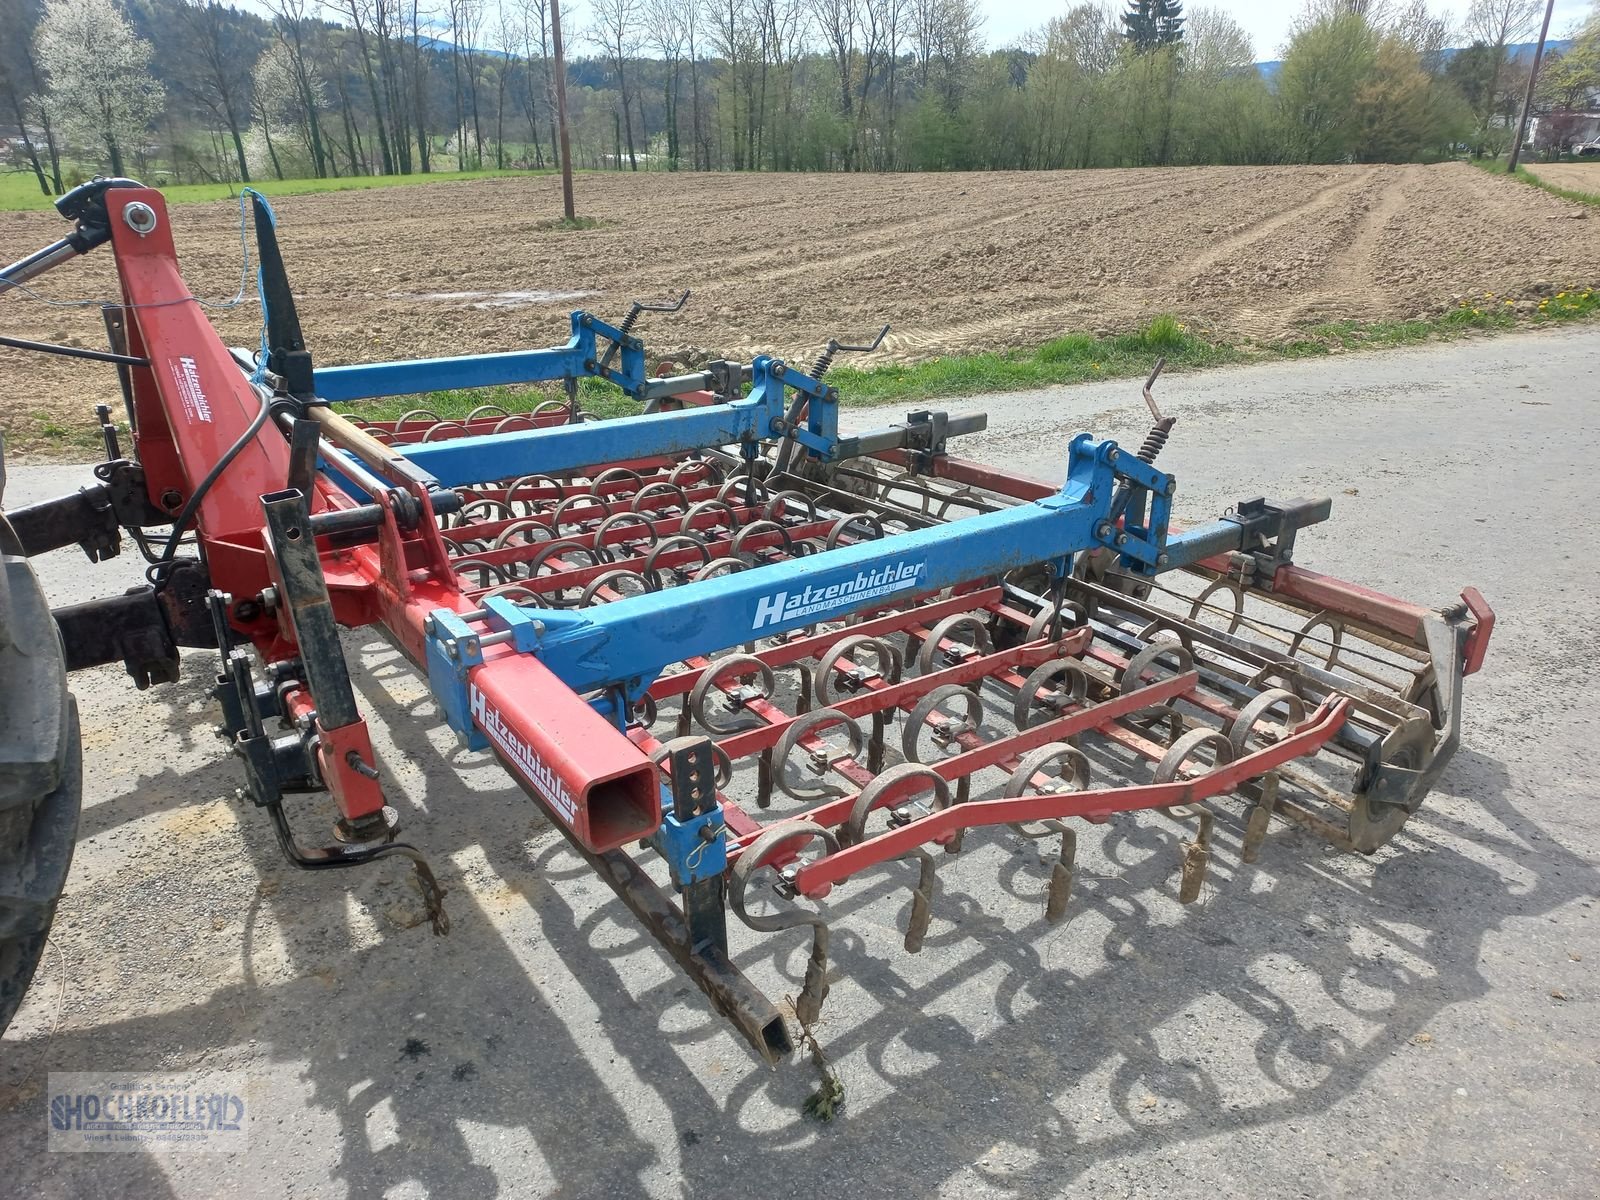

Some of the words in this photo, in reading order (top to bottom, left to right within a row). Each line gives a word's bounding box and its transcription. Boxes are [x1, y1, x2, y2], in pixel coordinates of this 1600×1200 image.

[180, 357, 212, 423] Hatzenbichler
[752, 561, 924, 629] Hatzenbichler
[795, 583, 897, 616] LANDMASCHINENBAU
[470, 682, 578, 816] Hatzenbichler
